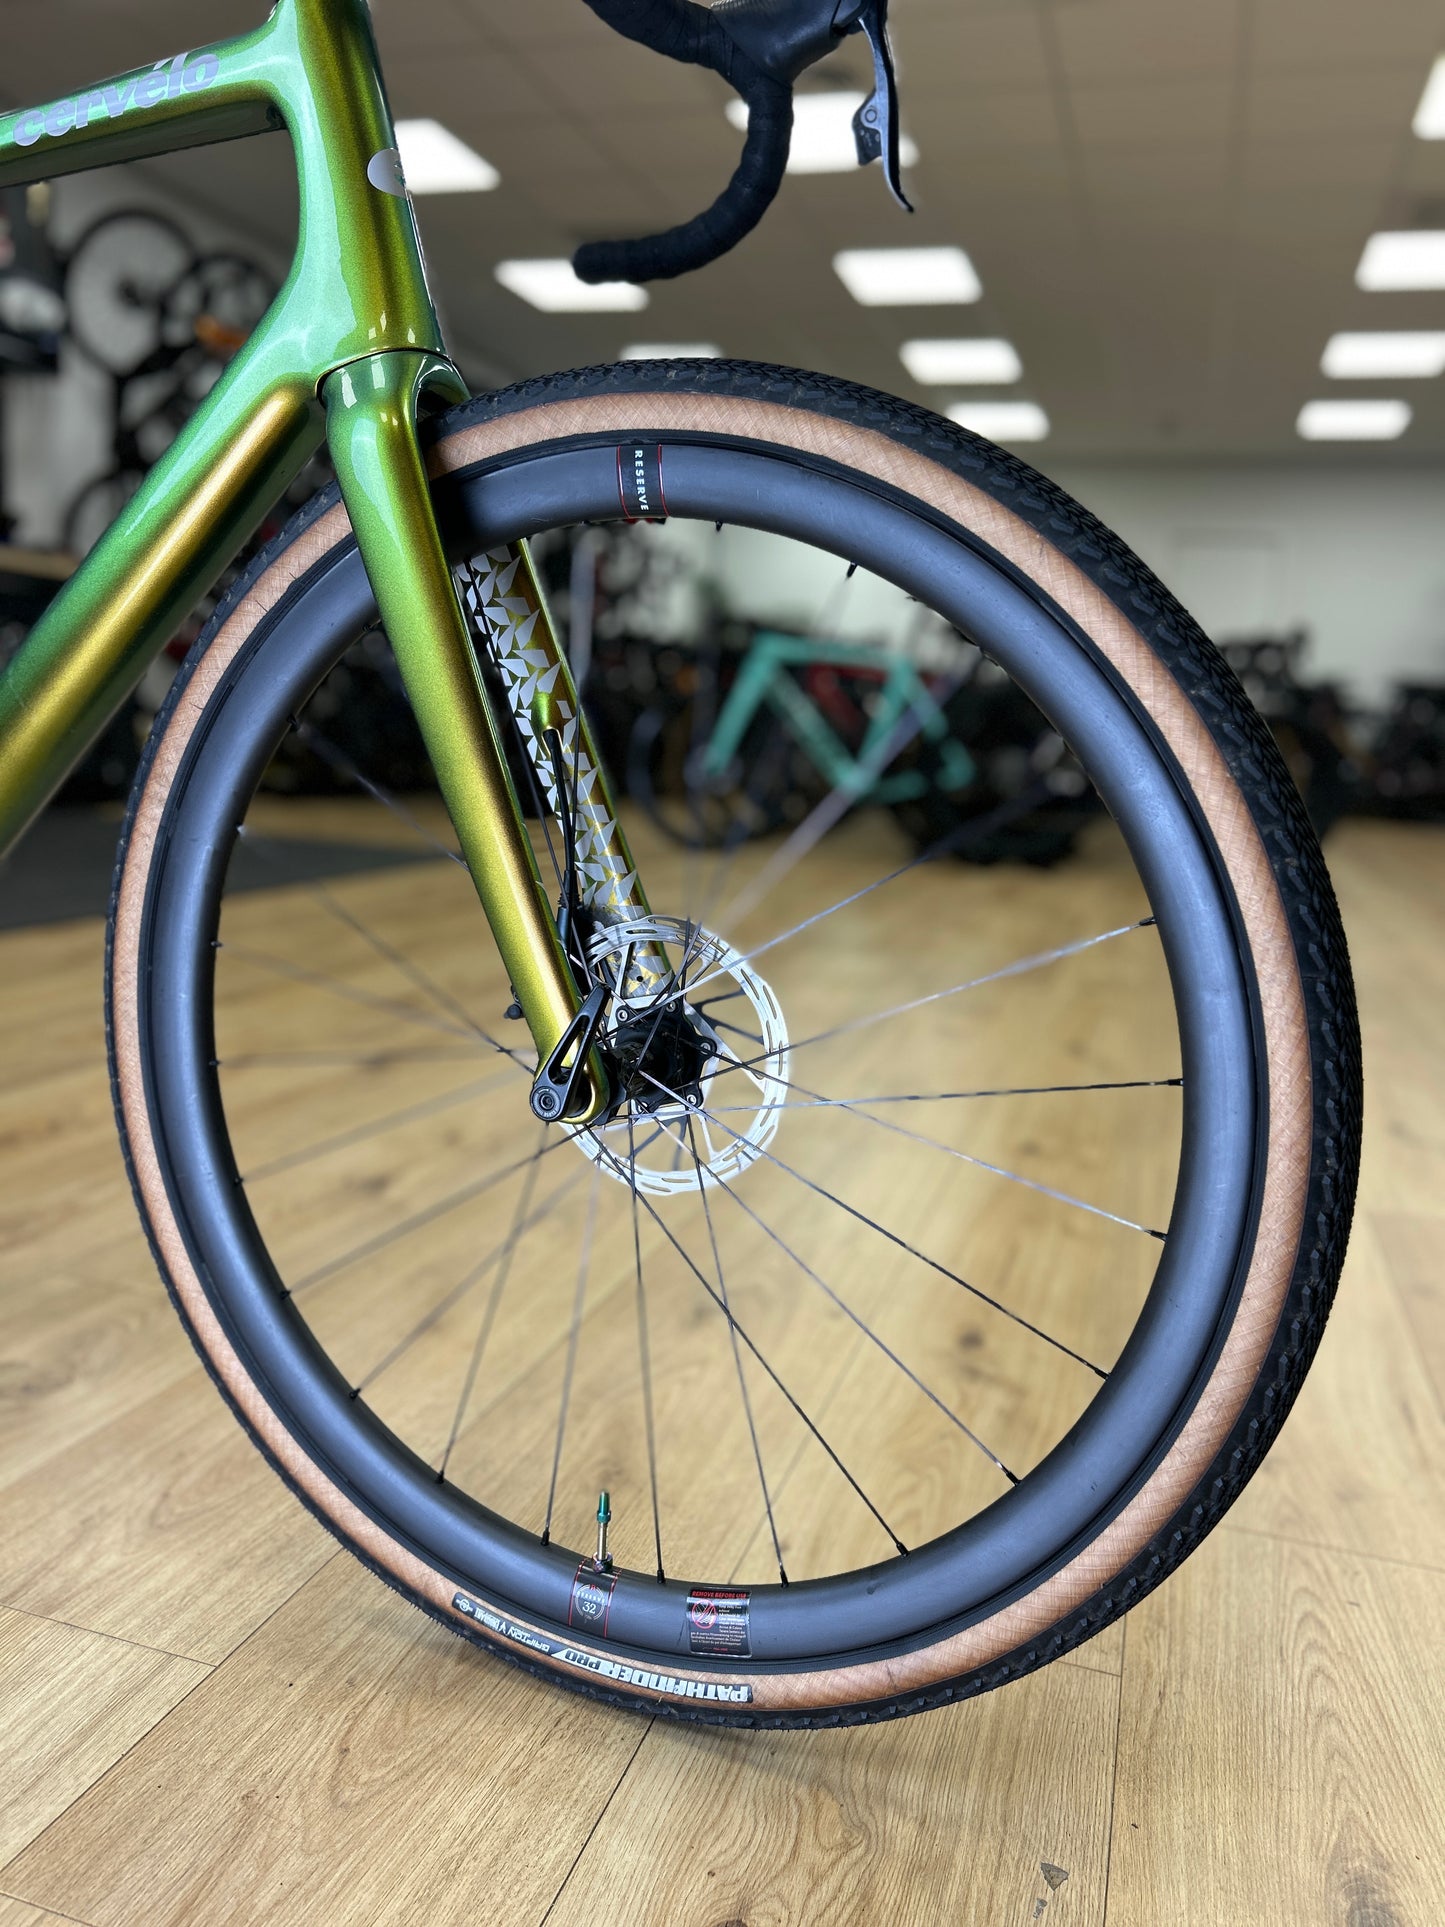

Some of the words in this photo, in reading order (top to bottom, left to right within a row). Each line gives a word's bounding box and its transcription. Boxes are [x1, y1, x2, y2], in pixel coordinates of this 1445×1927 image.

[13, 52, 220, 147] cervélo
[634, 449, 649, 510] RESERVE
[582, 1601, 597, 1615] 32
[507, 1626, 551, 1652] GRIPTON
[564, 1649, 602, 1671] PRO
[605, 1664, 748, 1703] PATHFINDER
